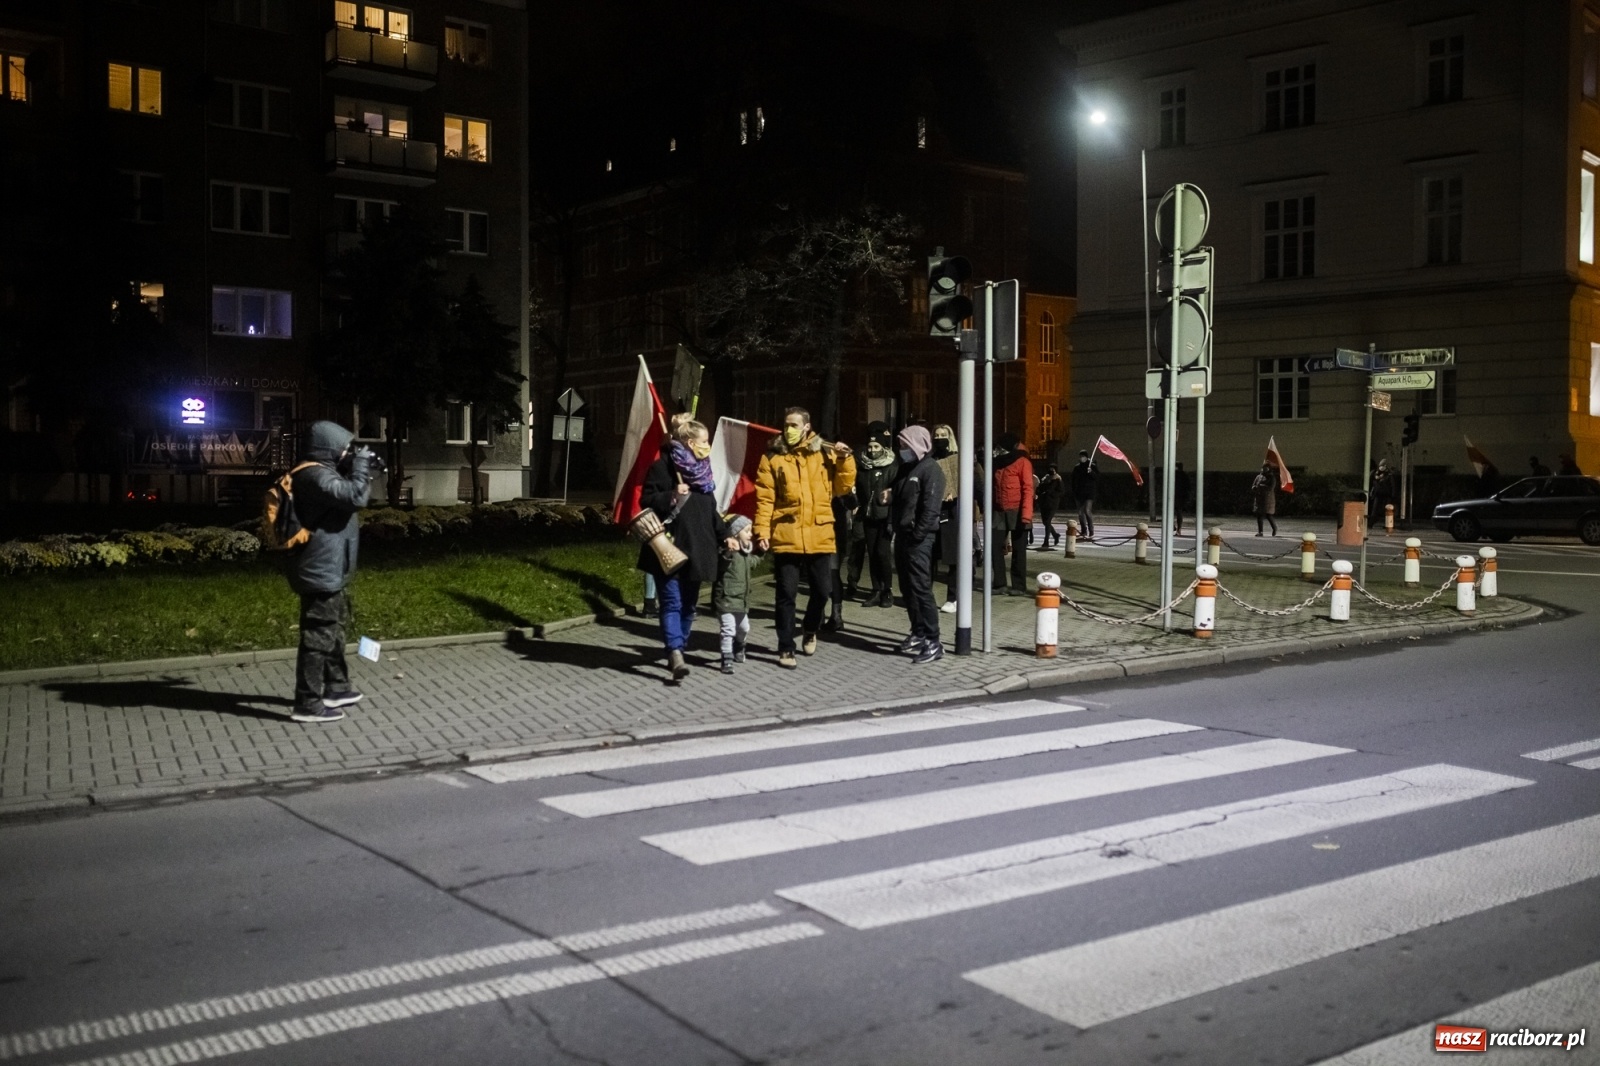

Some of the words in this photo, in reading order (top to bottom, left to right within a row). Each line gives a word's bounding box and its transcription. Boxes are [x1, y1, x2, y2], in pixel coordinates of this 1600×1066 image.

[1321, 359, 1334, 371] Wojs
[252, 376, 299, 389] DOMÓW
[1378, 376, 1401, 387] Aquapark
[151, 442, 197, 451] OSIEDLE
[200, 442, 254, 452] PARKOWE
